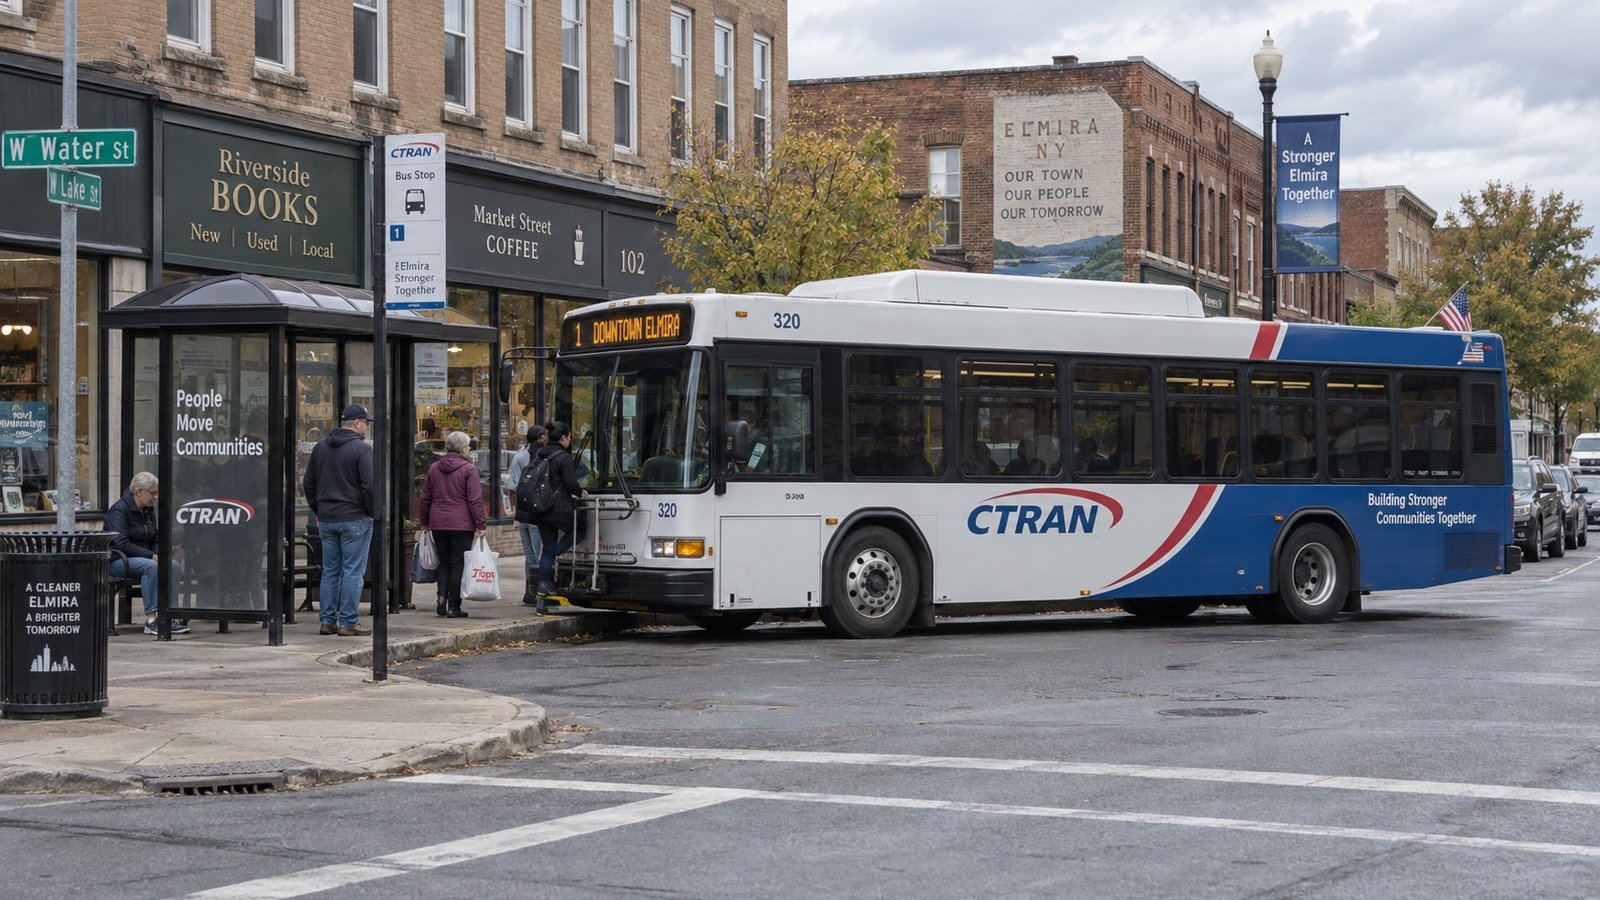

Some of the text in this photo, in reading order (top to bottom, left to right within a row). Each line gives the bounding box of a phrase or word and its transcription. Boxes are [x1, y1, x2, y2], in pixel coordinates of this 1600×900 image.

[1004, 118, 1099, 138] ELMIRA
[1304, 132, 1312, 145] A
[9, 136, 129, 161] W Water St
[391, 147, 432, 158] CTRAN
[1037, 143, 1066, 159] NY
[1282, 150, 1335, 166] Stronger
[218, 148, 311, 187] Riverside
[395, 170, 435, 181] Bus Stop
[1290, 168, 1328, 182] Elmira
[1005, 169, 1083, 183] OUR TOWN
[49, 172, 98, 203] W Lake St
[1004, 187, 1089, 201] OUR PEOPLE
[1282, 187, 1335, 204] Together
[211, 179, 319, 226] BOOKS
[474, 204, 552, 236] Market Street
[1000, 205, 1104, 220] OUR TOMORROW
[190, 223, 334, 259] New Used Local
[394, 228, 399, 239] 1
[486, 235, 539, 260] COFFEE
[620, 250, 645, 275] 102
[395, 273, 435, 285] Stronger
[395, 285, 436, 298] Together
[773, 312, 800, 329] 320
[576, 313, 680, 347] 1 DOWNTOWN ELMIRA
[176, 389, 222, 411] People
[176, 414, 213, 431] Move
[176, 437, 263, 456] Communities
[1368, 493, 1447, 509] Building Stronger
[176, 507, 241, 525] CTRAN
[658, 502, 677, 518] 320
[967, 504, 1099, 535] CTRAN
[1376, 511, 1476, 527] Communities Together
[26, 582, 81, 592] A CLEANER
[29, 596, 78, 607] ELMIRA
[26, 613, 81, 622] A BRIGHTER
[26, 625, 81, 634] TOMORROW
